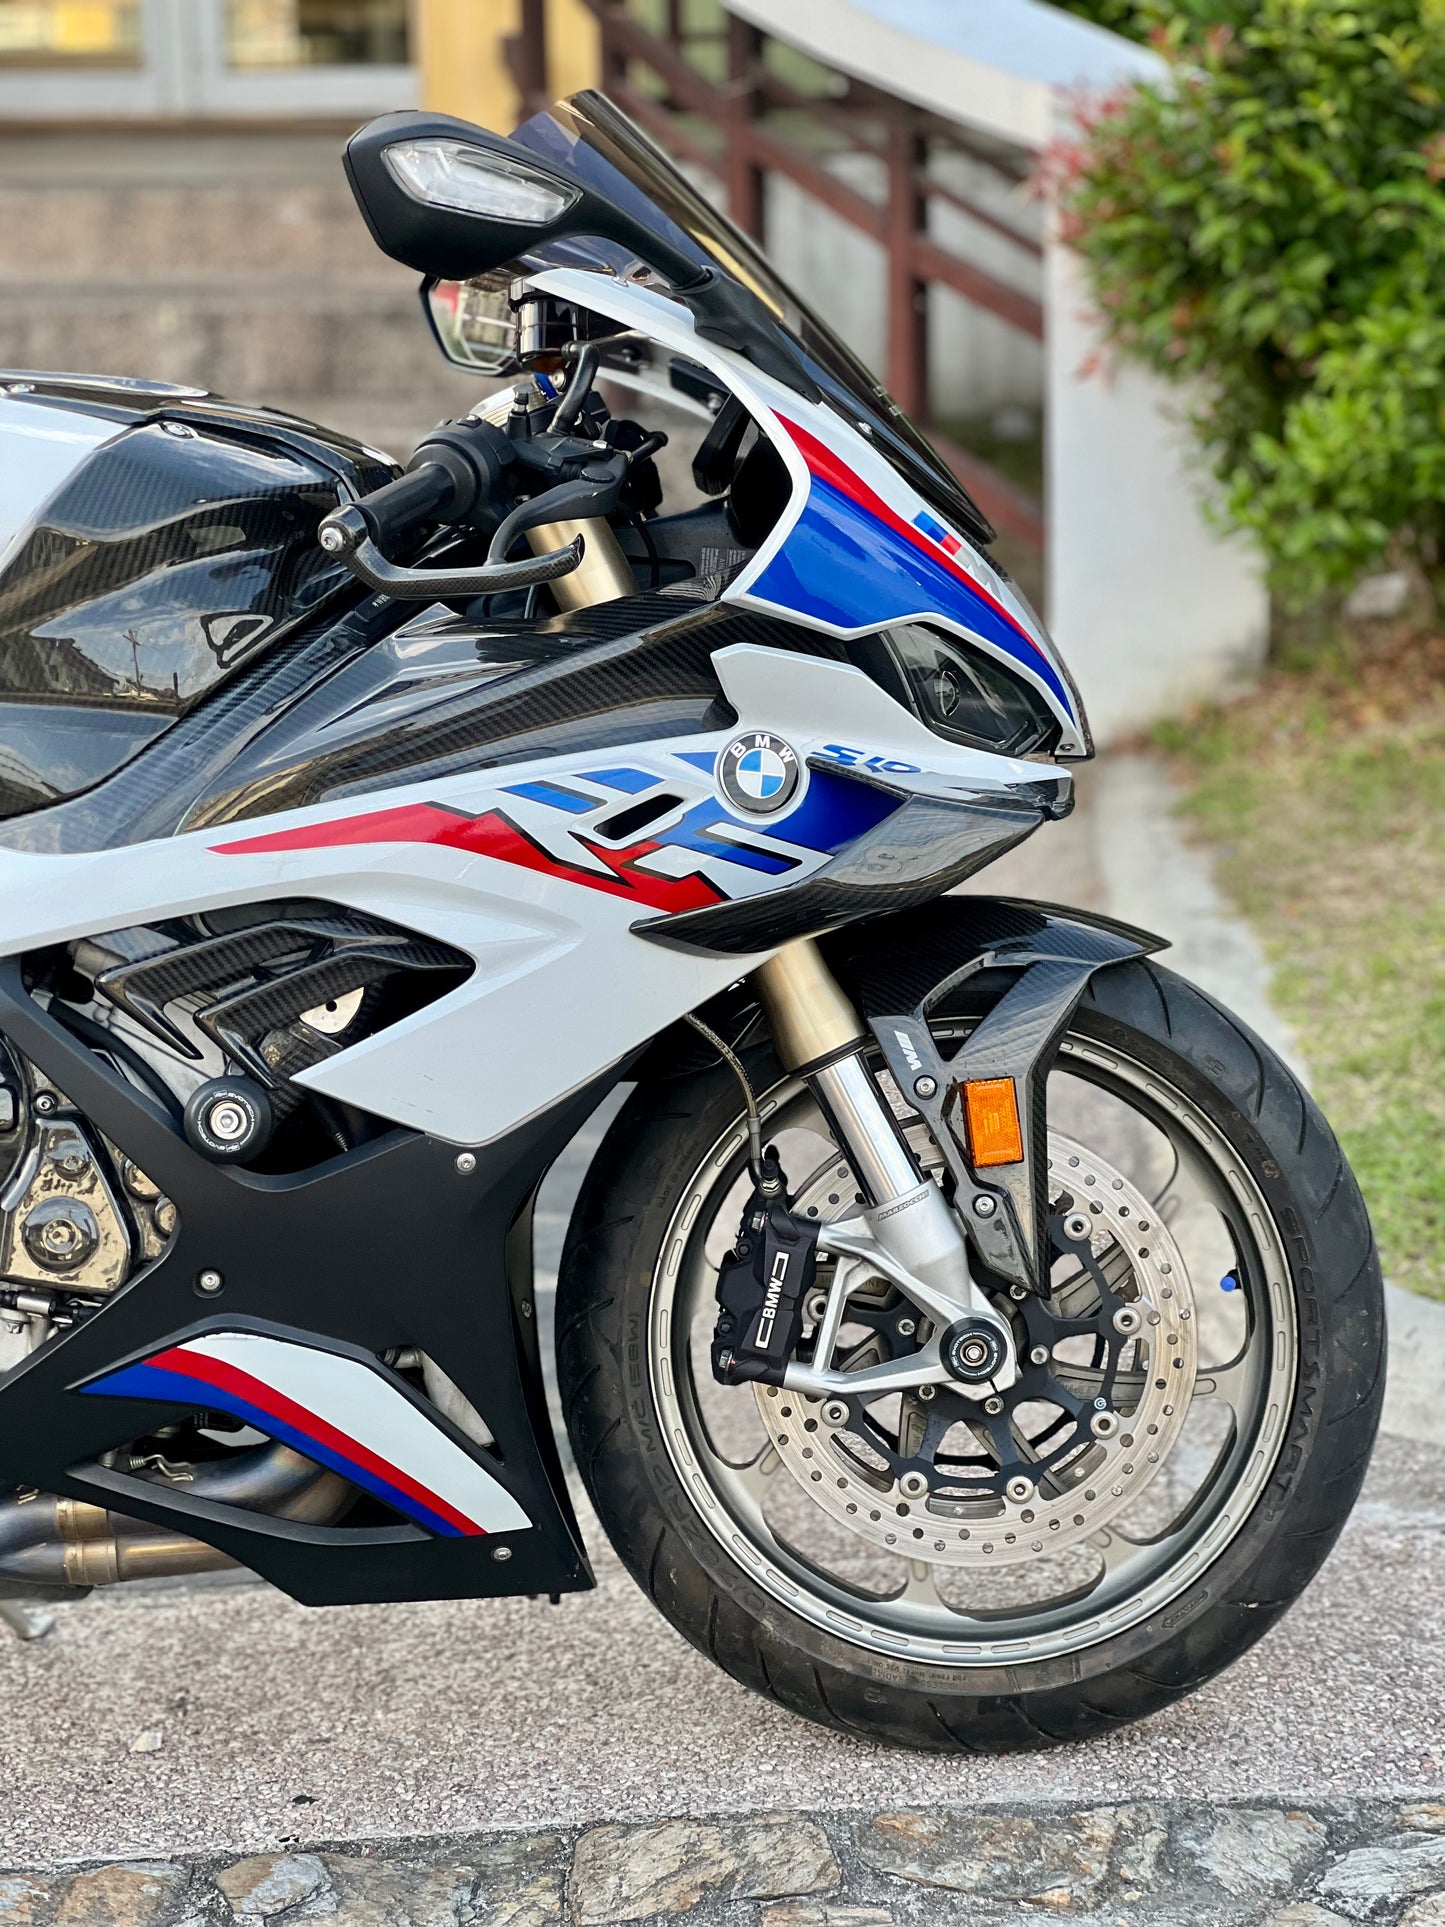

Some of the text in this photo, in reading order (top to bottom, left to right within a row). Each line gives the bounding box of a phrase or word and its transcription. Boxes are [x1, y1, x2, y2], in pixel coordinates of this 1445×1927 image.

[729, 734, 796, 763] BMW
[877, 1189, 930, 1221] MARZOCCHI
[762, 1277, 784, 1320] BMW
